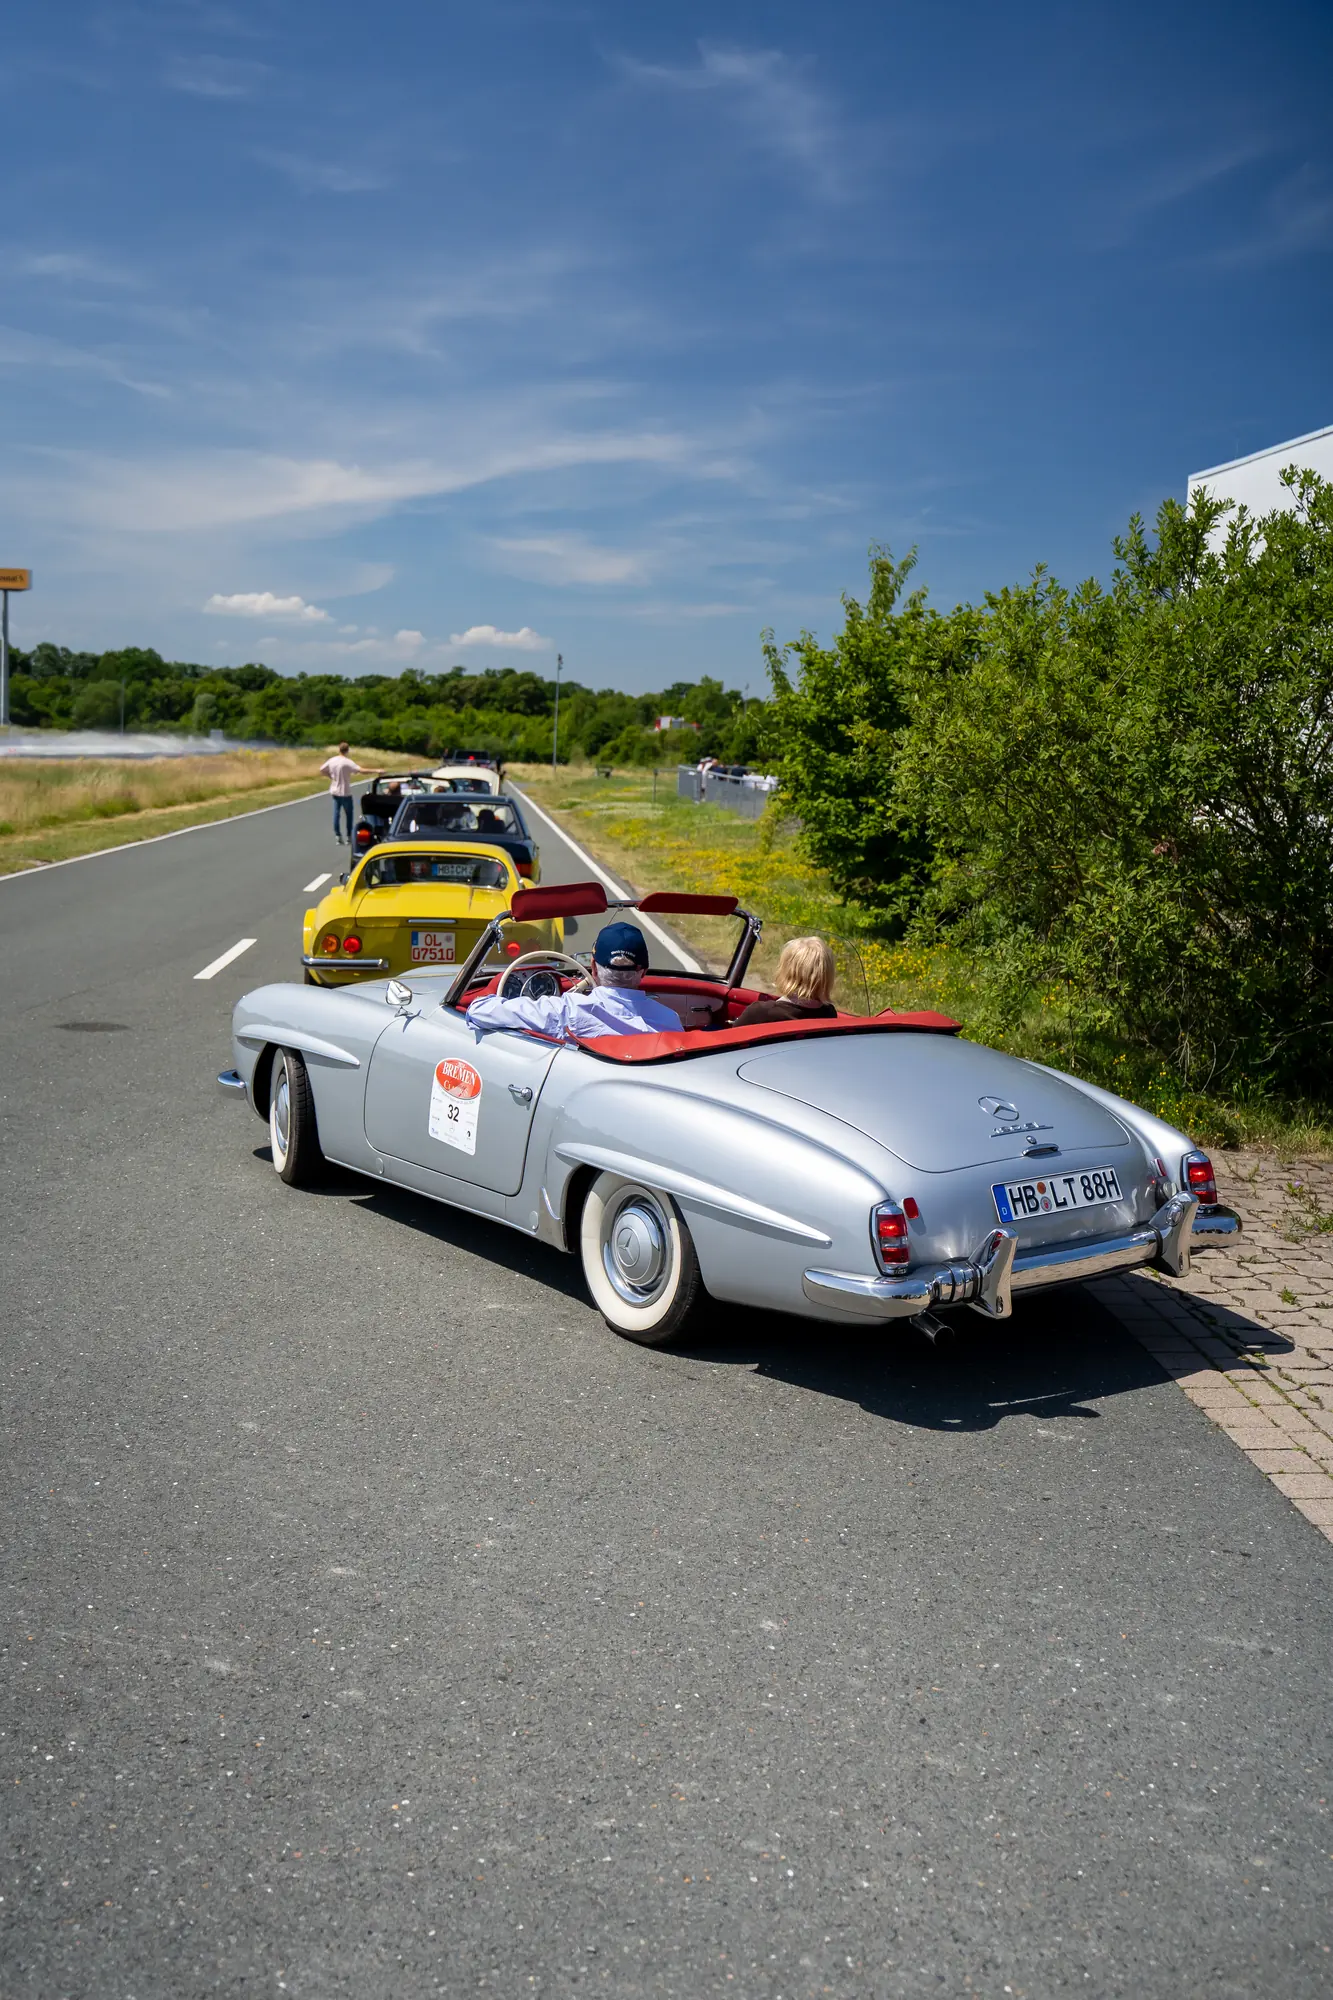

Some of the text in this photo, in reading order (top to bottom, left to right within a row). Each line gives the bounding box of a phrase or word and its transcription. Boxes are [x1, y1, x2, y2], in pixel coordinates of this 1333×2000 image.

[438, 865, 450, 875] HB
[424, 934, 442, 946] OL
[412, 948, 454, 961] 07510
[442, 1061, 477, 1086] BREMEN
[447, 1104, 460, 1122] 32
[1008, 1185, 1039, 1216] HB
[1049, 1177, 1077, 1208] LT
[1080, 1170, 1120, 1201] 88H
